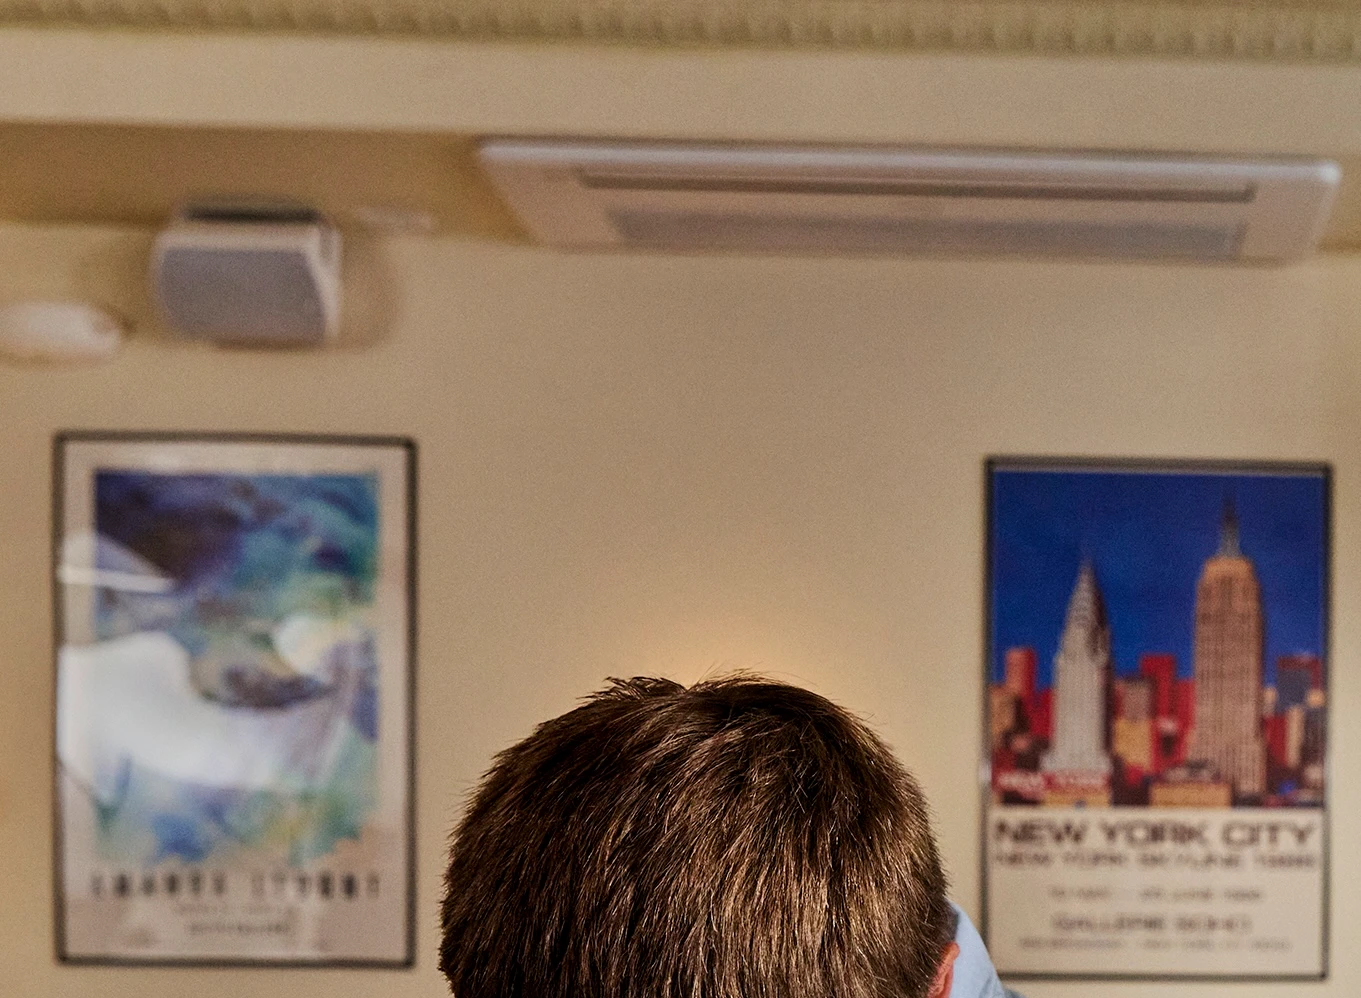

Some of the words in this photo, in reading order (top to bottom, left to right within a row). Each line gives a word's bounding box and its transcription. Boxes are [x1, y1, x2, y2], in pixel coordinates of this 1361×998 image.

[994, 819, 1088, 845] NEW
[1100, 819, 1210, 847] YORK
[1221, 820, 1316, 848] CITY
